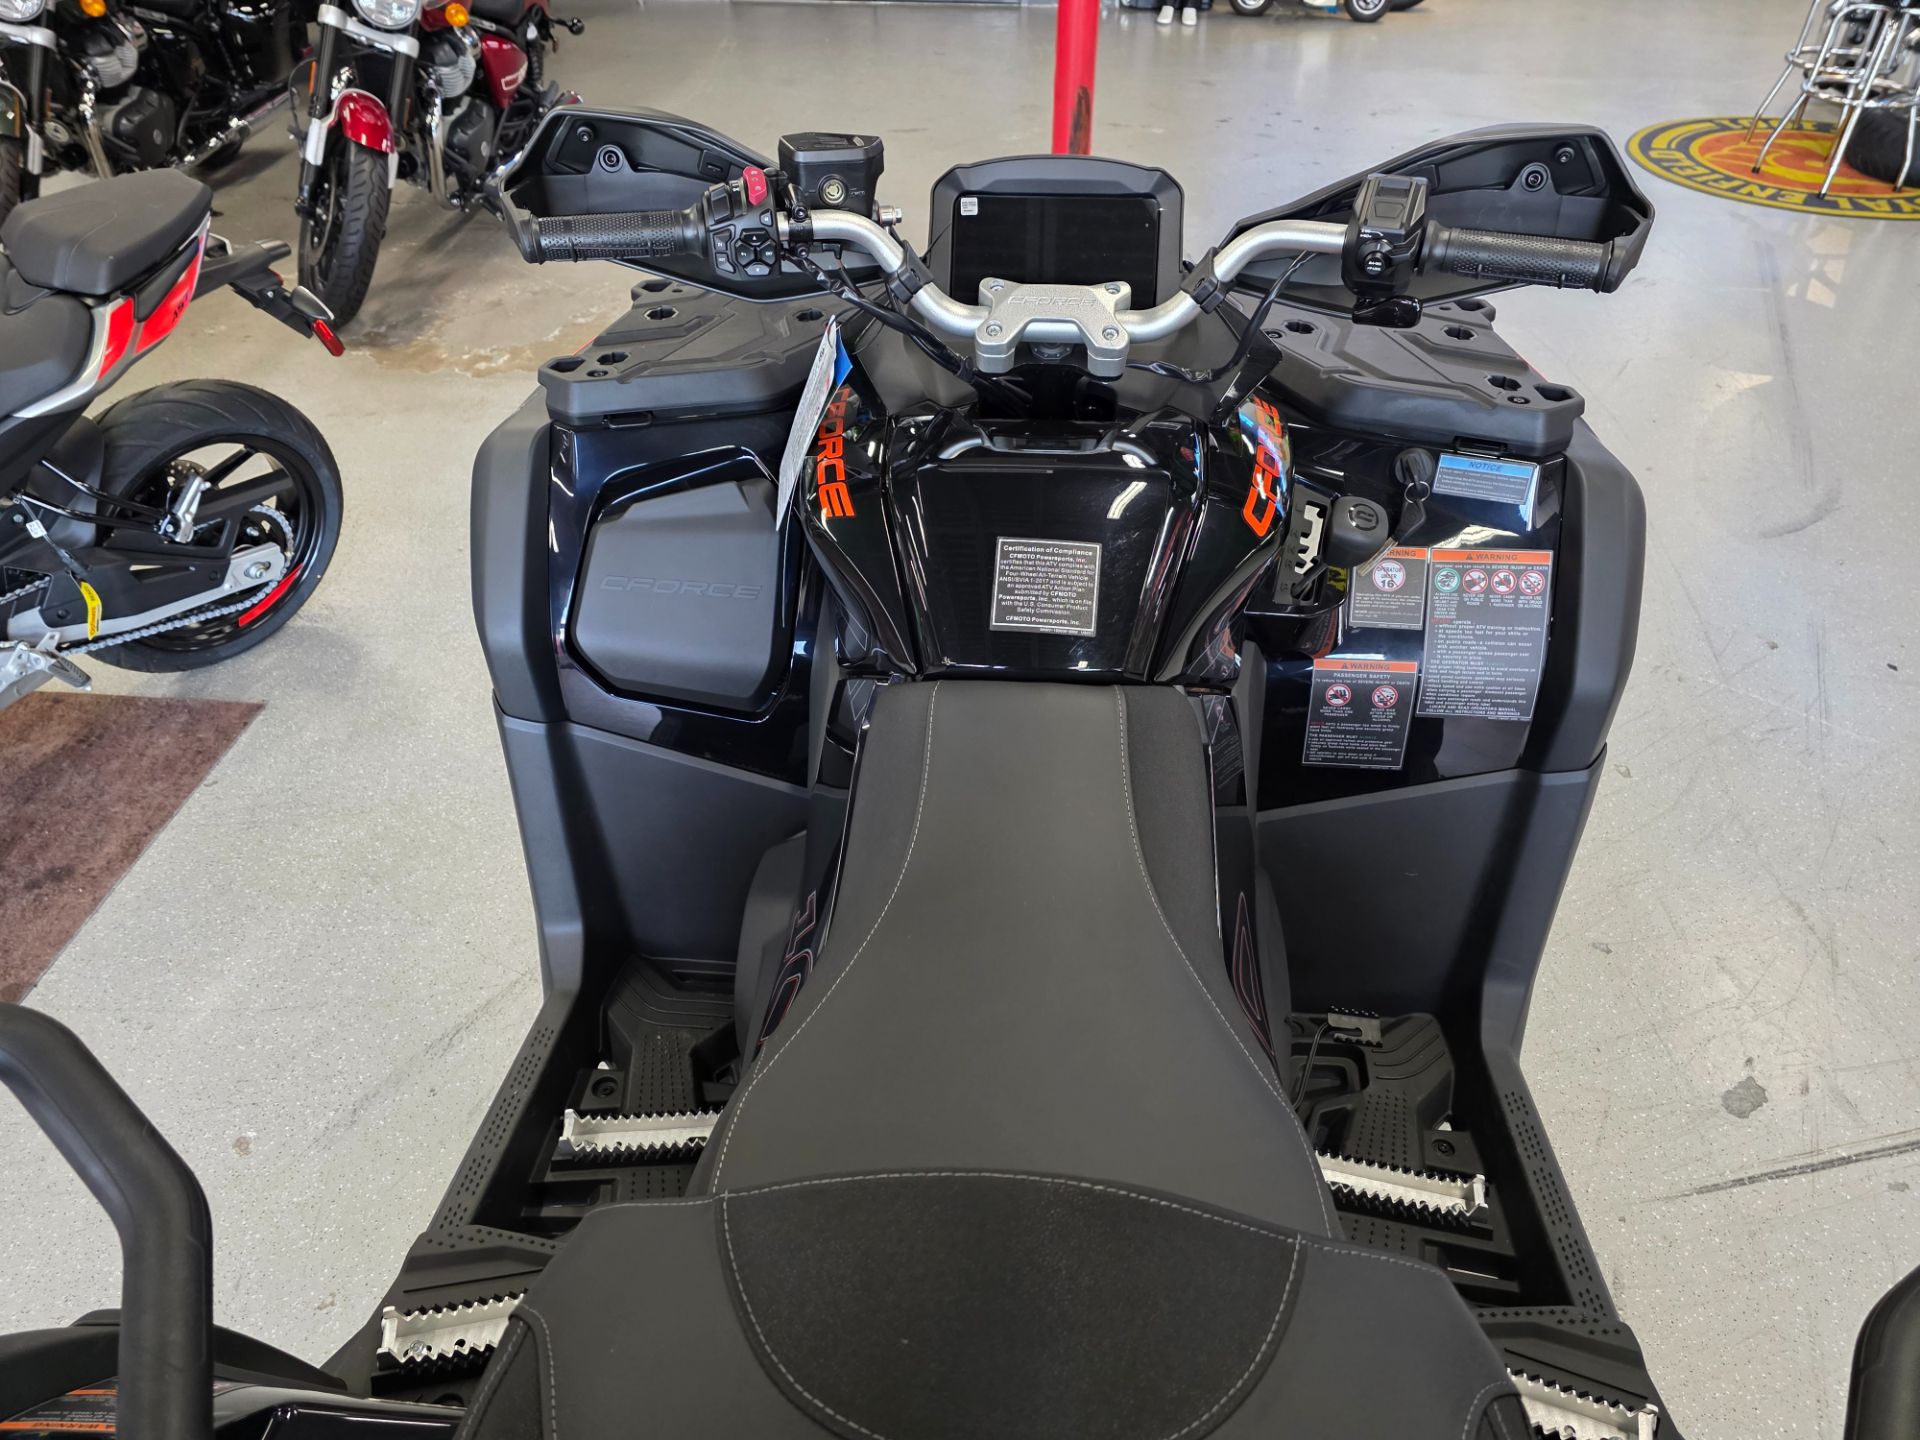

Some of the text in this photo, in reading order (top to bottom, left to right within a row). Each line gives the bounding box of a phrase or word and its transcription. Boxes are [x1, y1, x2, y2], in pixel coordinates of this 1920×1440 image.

[1648, 149, 1808, 205] ENFIELD
[1007, 295, 1099, 306] CFORCE
[1469, 461, 1503, 472] NOTICE
[1053, 548, 1092, 556] Compliance
[600, 574, 762, 599] CFORCE
[1381, 580, 1394, 588] 16
